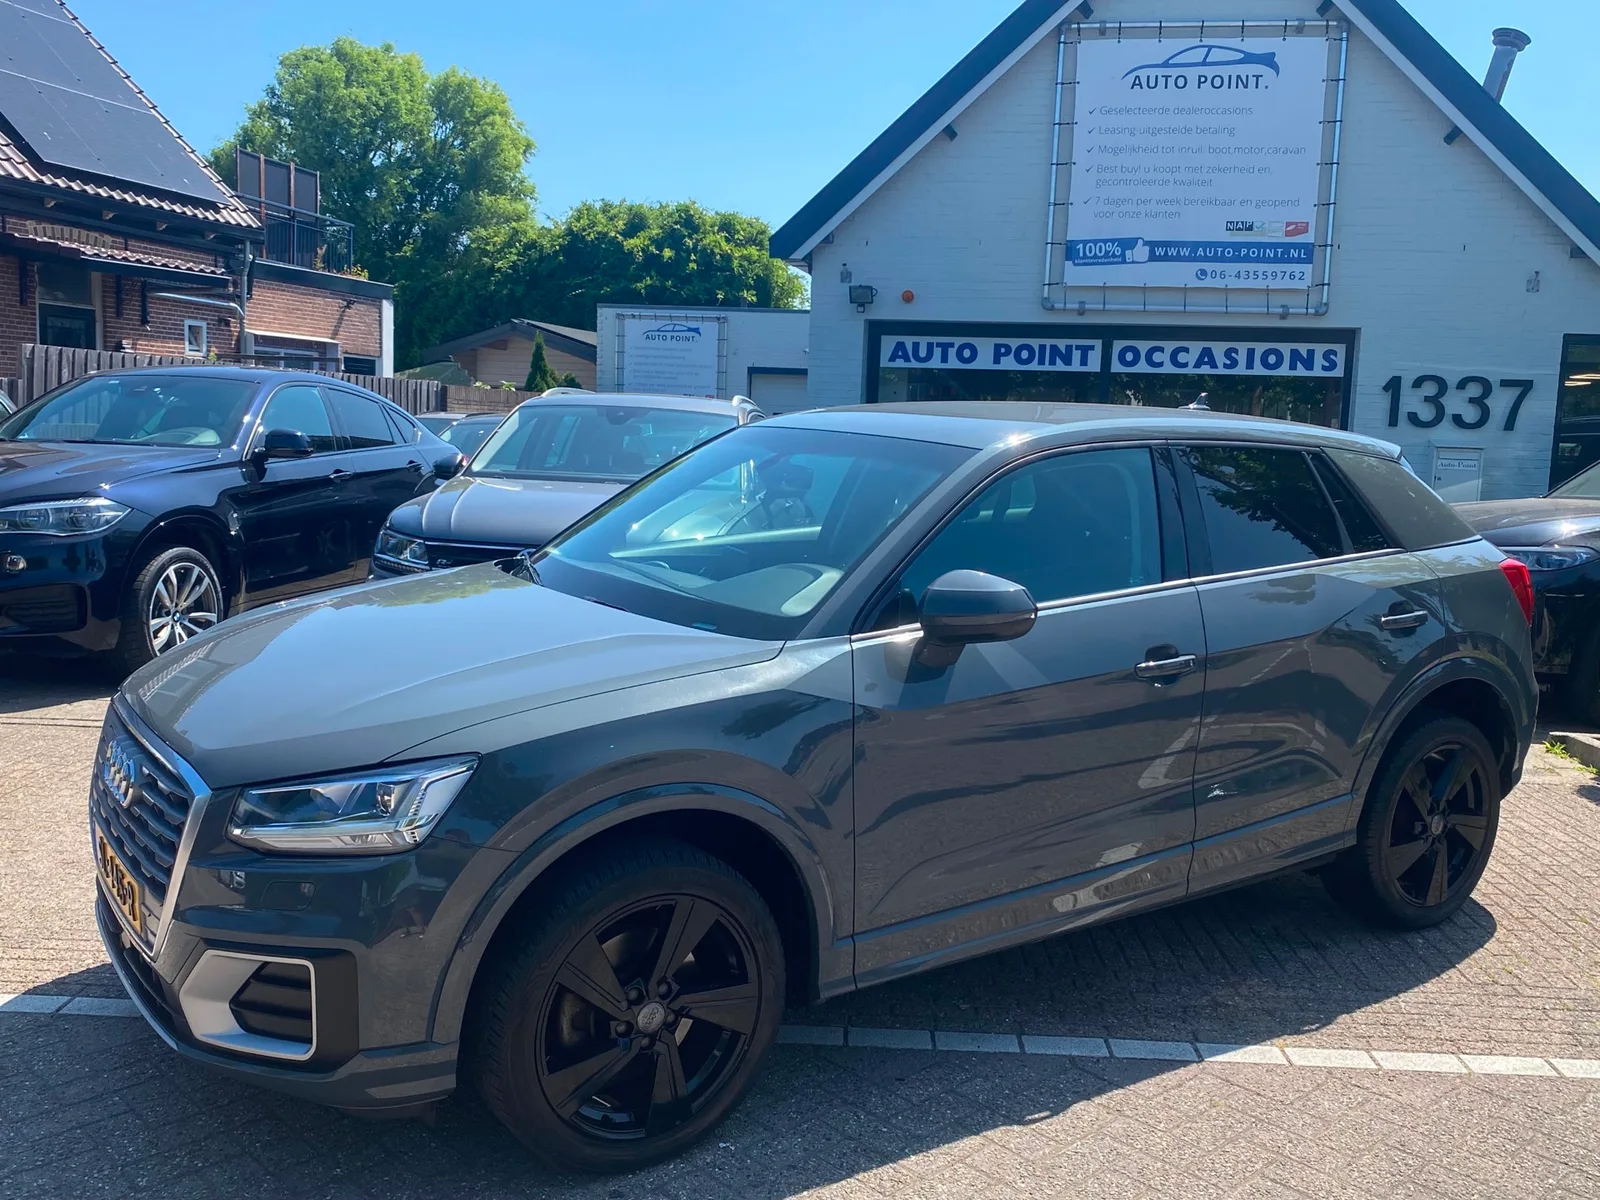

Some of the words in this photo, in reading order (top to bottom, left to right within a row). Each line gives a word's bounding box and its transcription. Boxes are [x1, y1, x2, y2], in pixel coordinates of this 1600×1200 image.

[1130, 74, 1188, 90] AUTO
[1197, 74, 1269, 90] POINT.
[1099, 104, 1170, 116] Geselecteerde
[1173, 104, 1254, 116] dealeroccasions
[1195, 124, 1236, 137] betaling
[1098, 144, 1159, 157] Mogelijkheid
[1161, 145, 1174, 155] tot
[1096, 164, 1117, 175] Best
[1120, 164, 1141, 178] buy!
[1143, 167, 1150, 175] u
[1153, 164, 1181, 177] koopt
[1184, 166, 1203, 175] met
[1206, 164, 1254, 176] zekerheid
[1095, 177, 1171, 189] gecontroleerde
[1173, 177, 1213, 188] kwaliteit
[1095, 196, 1101, 206] 7
[1103, 196, 1134, 209] dagen
[1136, 197, 1153, 208] per
[1155, 196, 1182, 207] week
[1183, 196, 1236, 208] bereikbaar
[1239, 198, 1253, 207] en
[1254, 197, 1300, 209] geopend
[1093, 210, 1115, 219] voor
[1118, 210, 1142, 219] onze
[1144, 208, 1181, 219] klanten
[1226, 221, 1254, 231] NAP
[1076, 242, 1122, 257] 100%
[1155, 246, 1308, 259] WWW.AUTO-POINT.NL
[1210, 270, 1306, 281] 06-43559762
[645, 334, 668, 342] AUTO
[887, 340, 979, 365] AUTO
[992, 342, 1095, 368] POINT
[1117, 344, 1339, 372] OCCASIONS
[1382, 374, 1534, 432] 1337
[1438, 461, 1477, 469] Auto-Point
